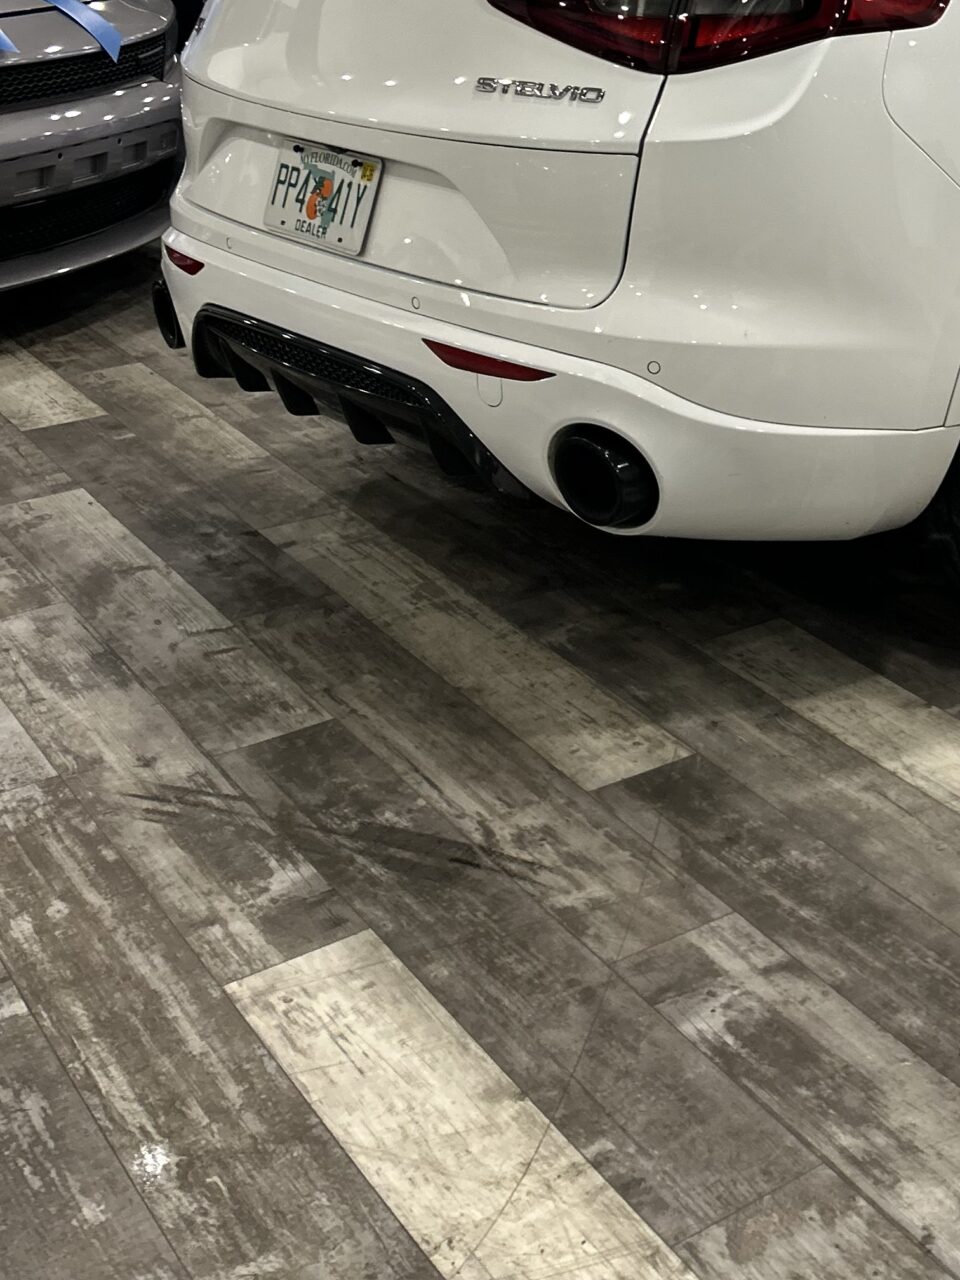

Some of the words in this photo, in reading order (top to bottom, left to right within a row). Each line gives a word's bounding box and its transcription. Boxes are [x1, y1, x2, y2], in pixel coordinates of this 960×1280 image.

[475, 77, 605, 104] STELVIO
[271, 163, 312, 213] PP4
[328, 178, 367, 228] 41Y
[295, 219, 328, 239] DEALER
